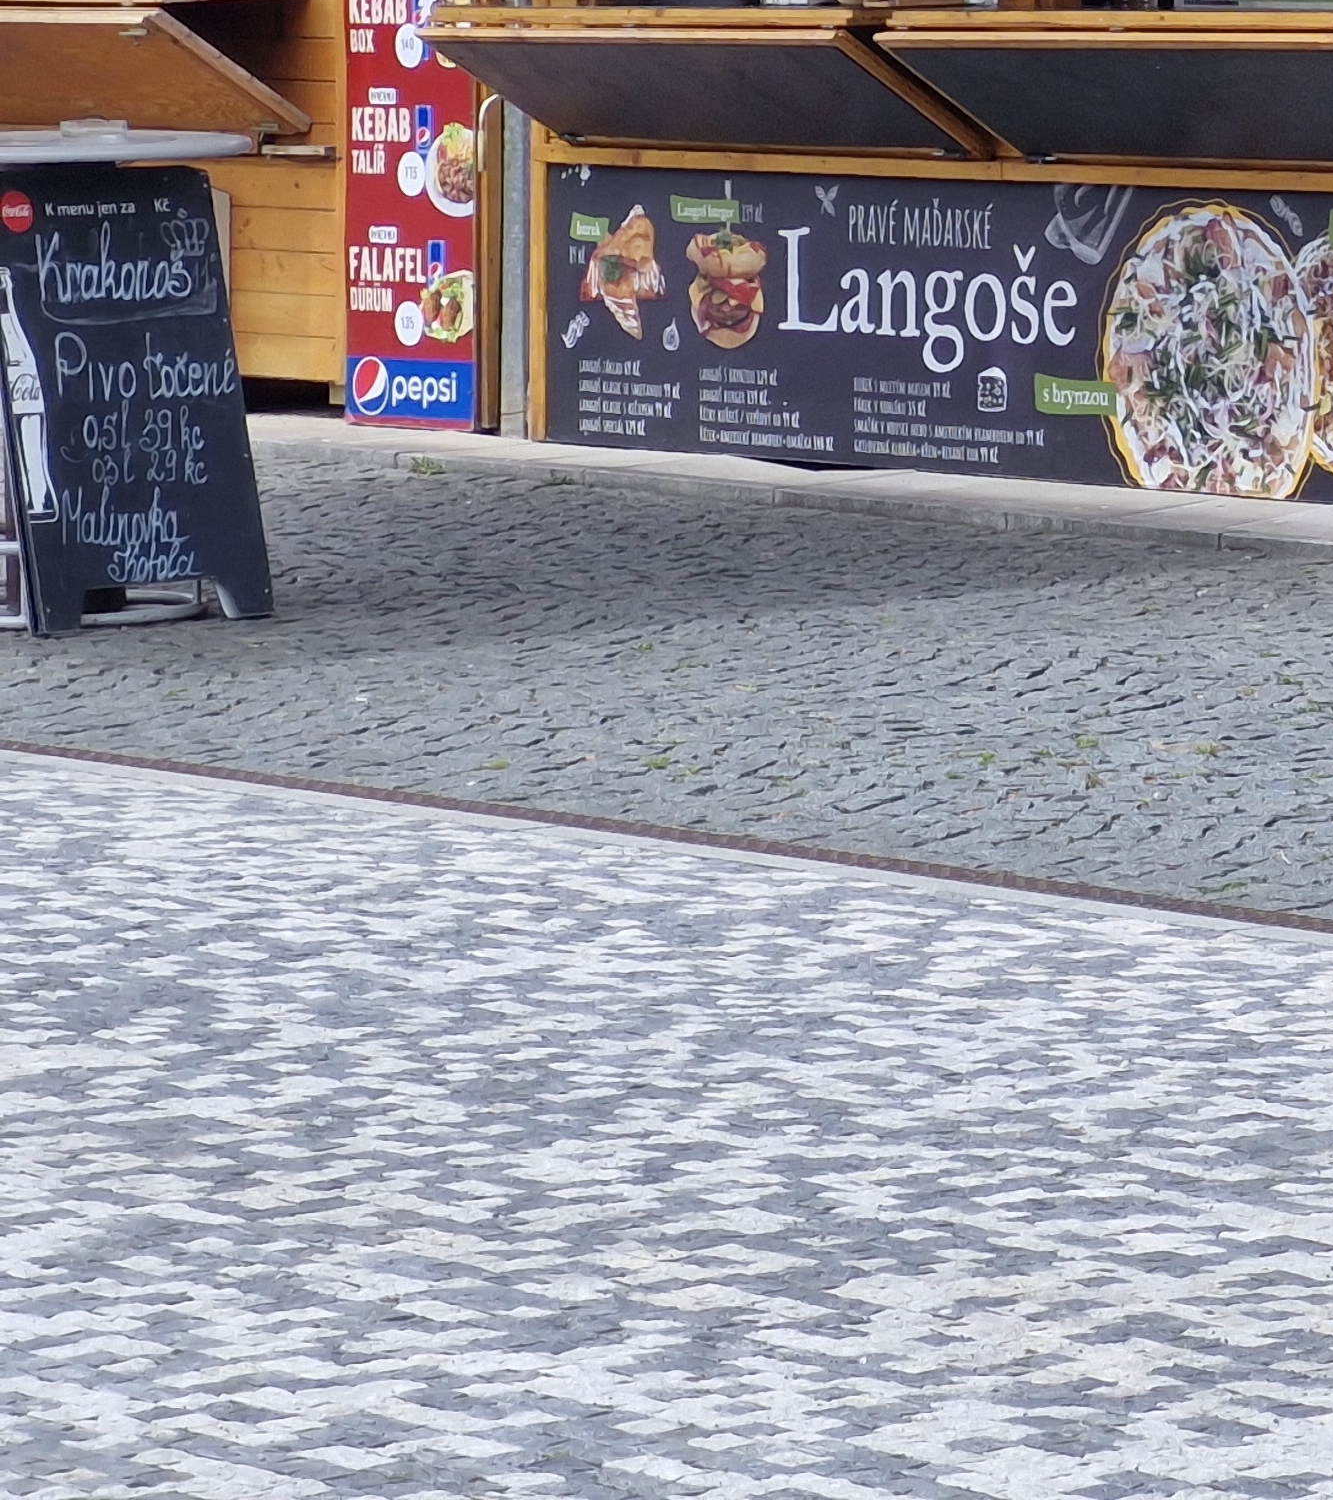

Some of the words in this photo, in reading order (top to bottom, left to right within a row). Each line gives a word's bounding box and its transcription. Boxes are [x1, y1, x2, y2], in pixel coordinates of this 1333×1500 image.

[350, 28, 375, 53] BOX
[352, 106, 411, 142] KEBAB
[351, 143, 385, 175] TALÍŘ
[45, 202, 54, 216] K
[58, 203, 94, 216] menu
[97, 201, 117, 218] jen
[121, 202, 136, 214] za
[154, 198, 170, 212] Kč
[849, 200, 898, 245] PRAVÉ
[903, 198, 994, 250] MAĎARSKÉ
[349, 246, 427, 283] FALAFEL
[350, 281, 393, 312] DÜRÜM
[778, 227, 1077, 373] Langoše
[55, 331, 136, 403] Pivo
[143, 332, 236, 400] točené
[391, 371, 457, 409] pepsi
[1042, 389, 1050, 403] s
[1052, 384, 1109, 410] brynzou
[142, 408, 173, 454] 39
[61, 484, 191, 547] Malinovka
